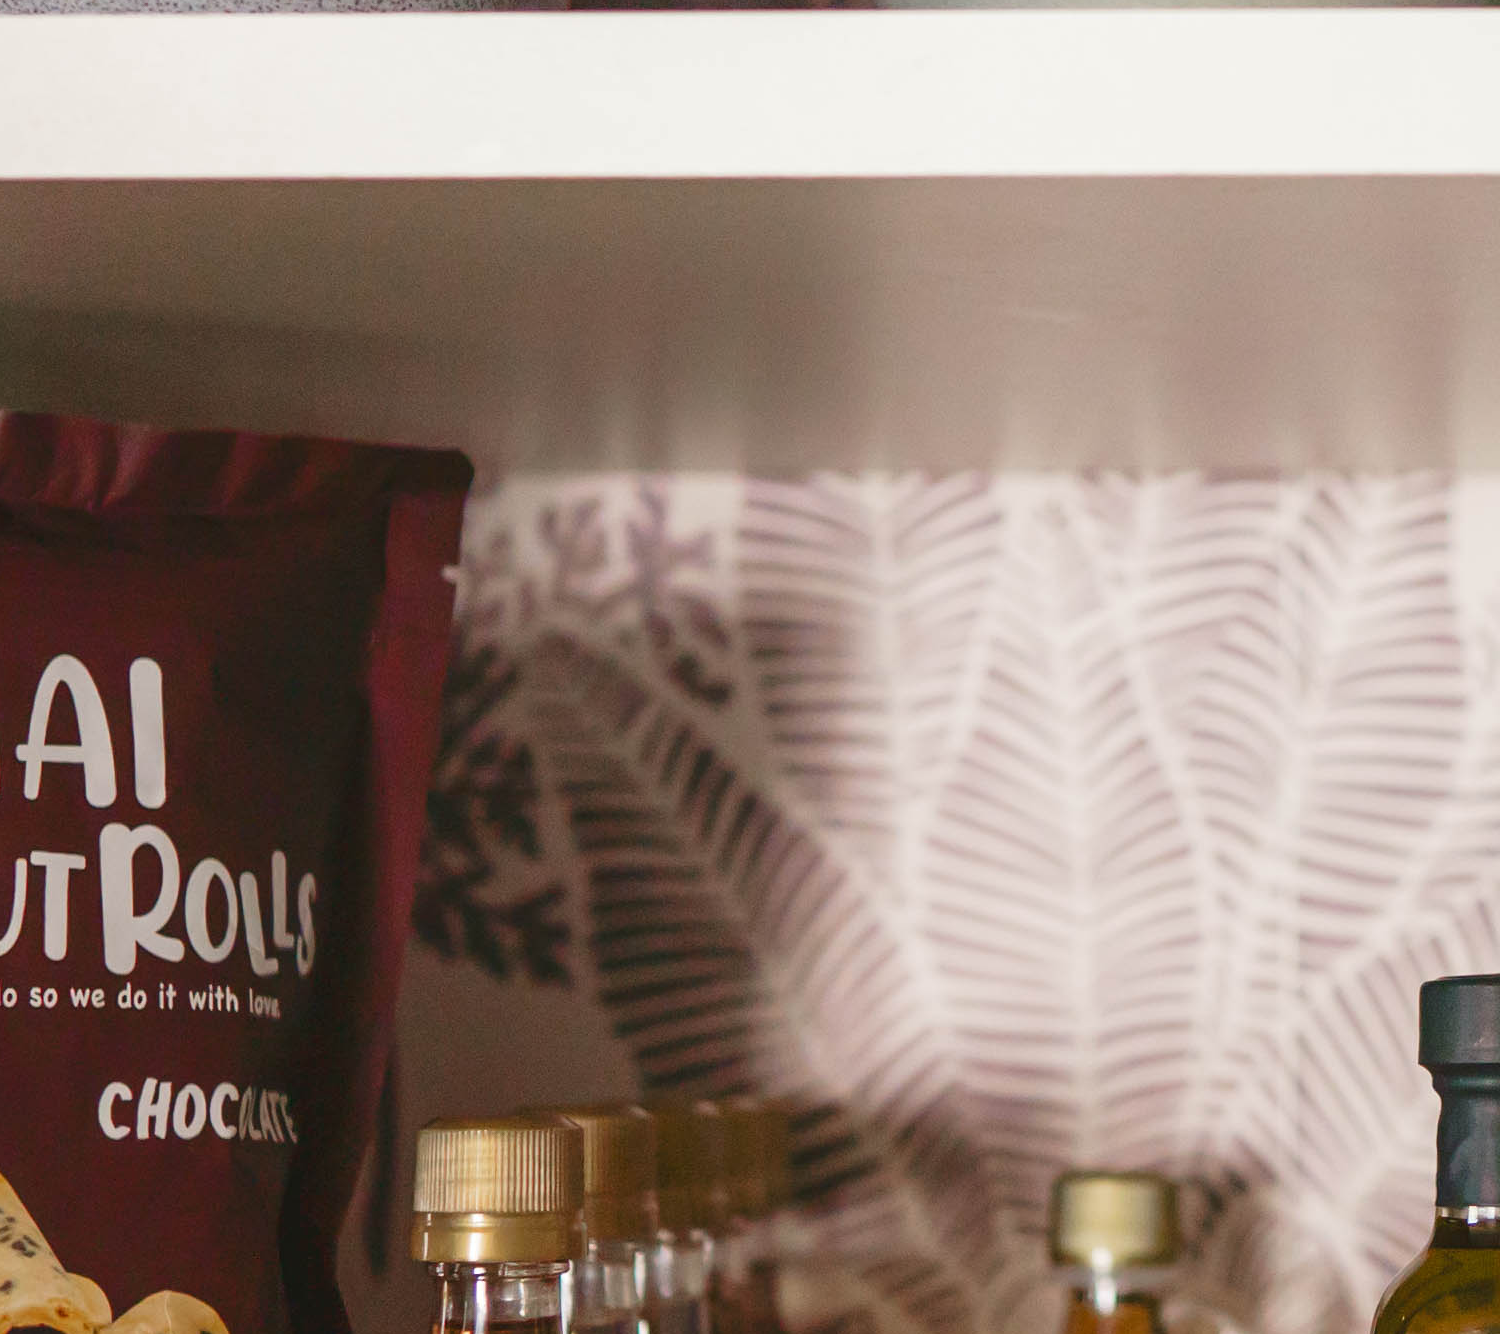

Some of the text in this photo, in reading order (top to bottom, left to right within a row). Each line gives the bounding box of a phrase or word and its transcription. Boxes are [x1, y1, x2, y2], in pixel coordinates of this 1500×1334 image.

[29, 986, 58, 1008] so
[69, 986, 105, 1009] we
[117, 981, 148, 1010] do
[158, 981, 177, 1009] it
[188, 984, 240, 1014] with
[97, 1077, 299, 1144] CHOCOLATE
